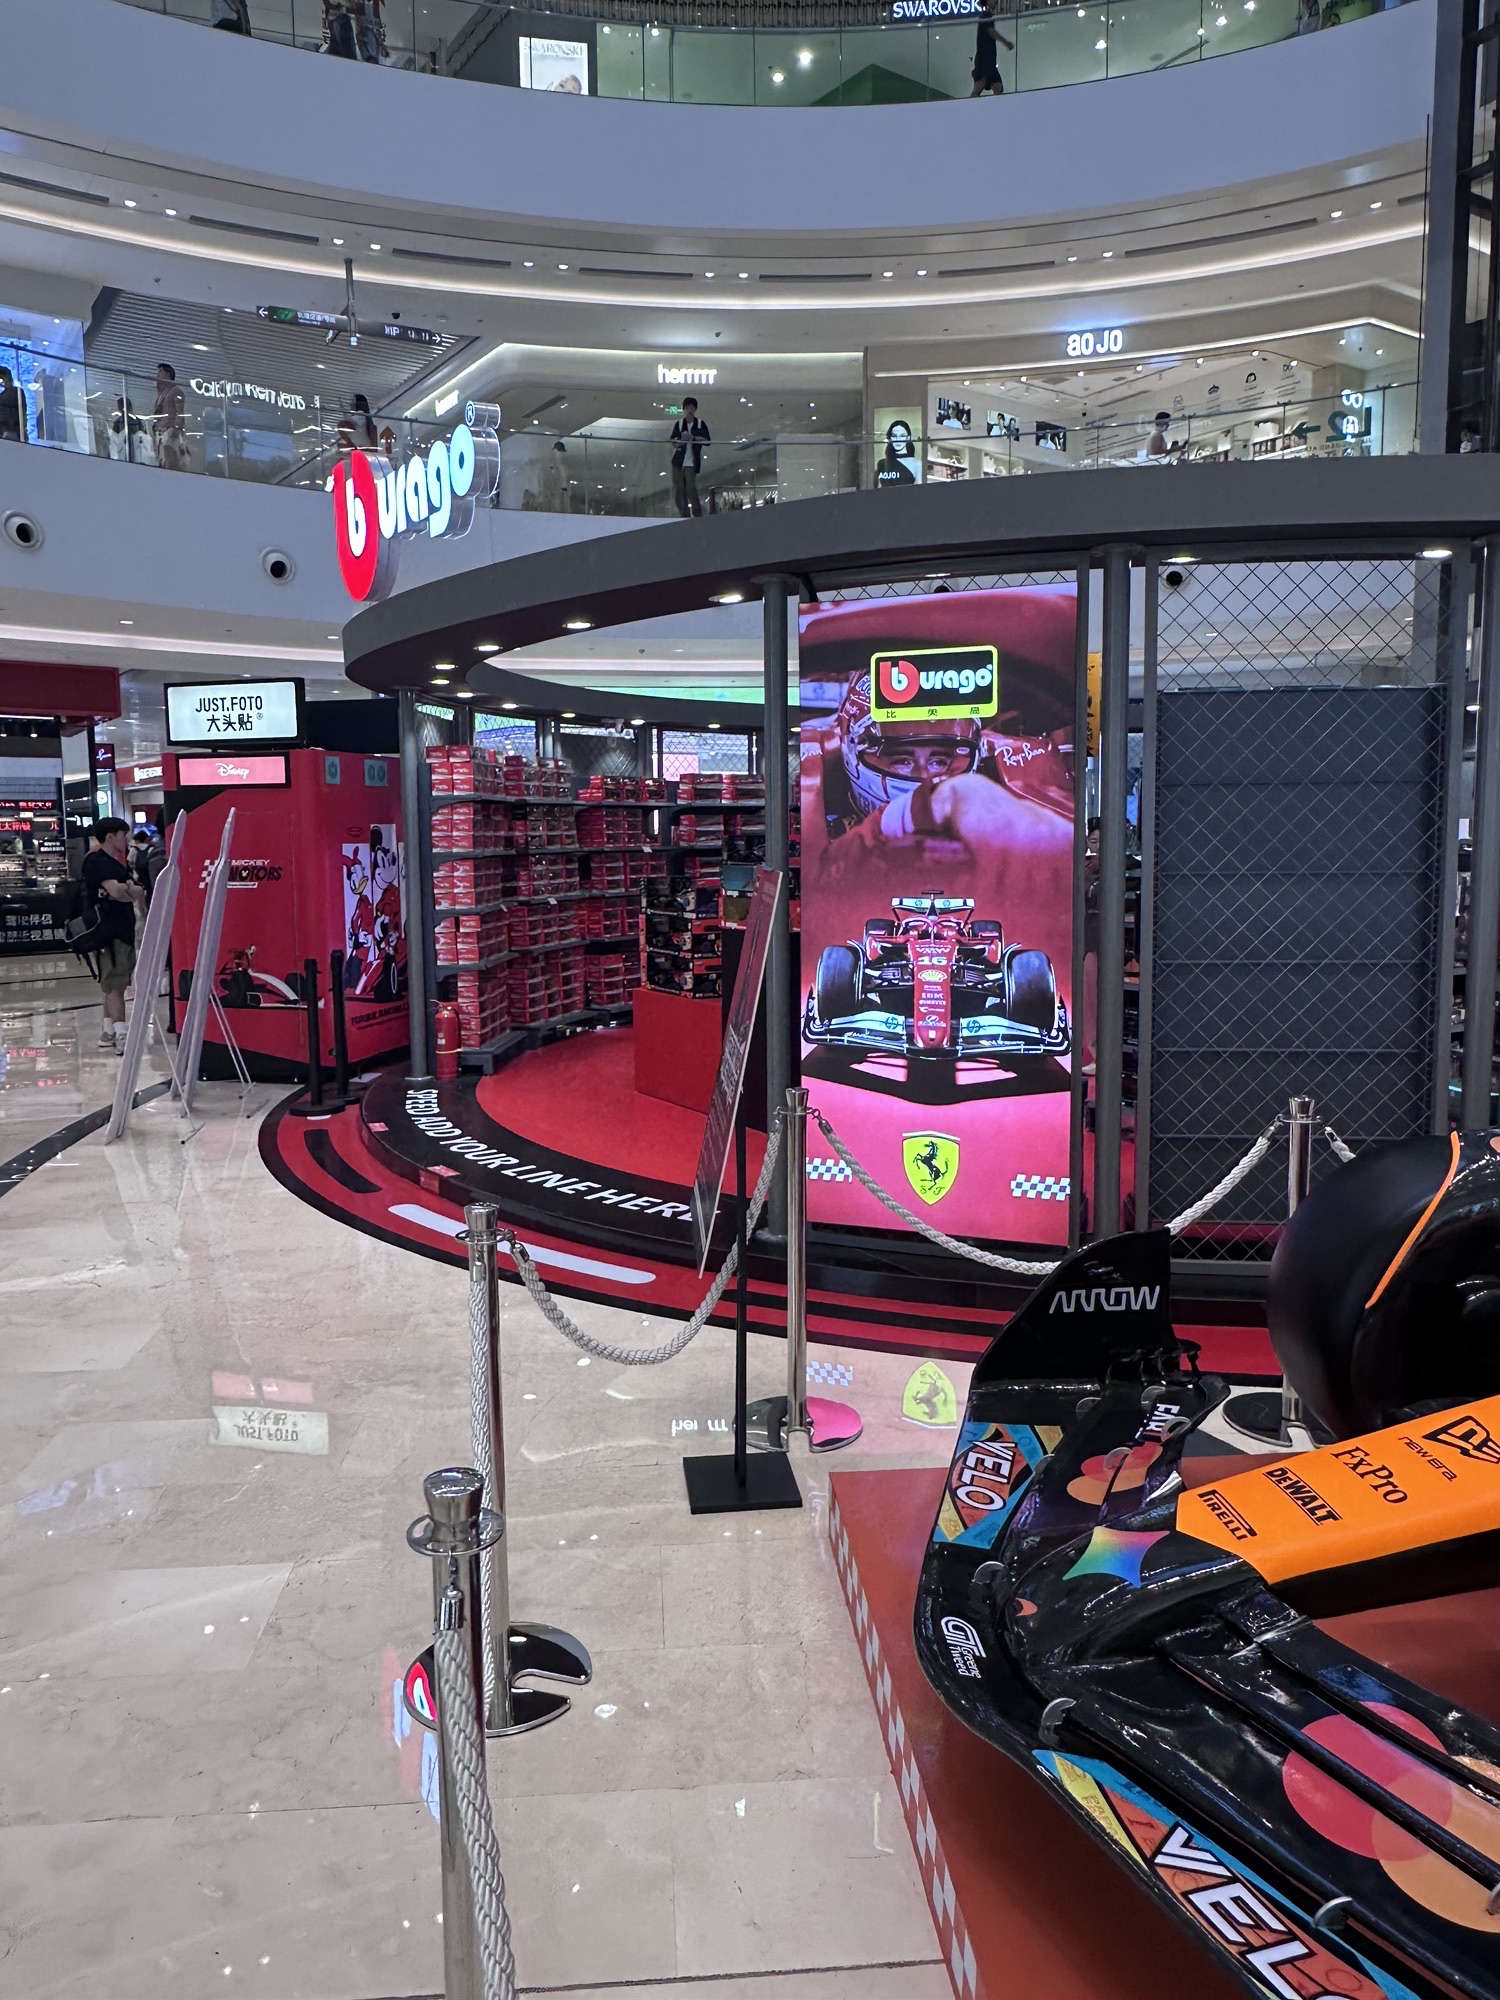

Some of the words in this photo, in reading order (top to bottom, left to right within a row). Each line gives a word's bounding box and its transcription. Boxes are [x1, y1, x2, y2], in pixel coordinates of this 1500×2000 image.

[892, 0, 985, 18] SWAROVSK
[411, 1116, 462, 1138] ADD
[440, 1135, 519, 1169] YOUR
[501, 1164, 602, 1195] LINE
[584, 1188, 693, 1222] HER
[1049, 1285, 1160, 1315] ARROW
[955, 1440, 1017, 1512] VELO
[1329, 1445, 1409, 1505] FxPro
[1197, 1488, 1259, 1541] PIRELLI
[1152, 1823, 1356, 2000] VEL
